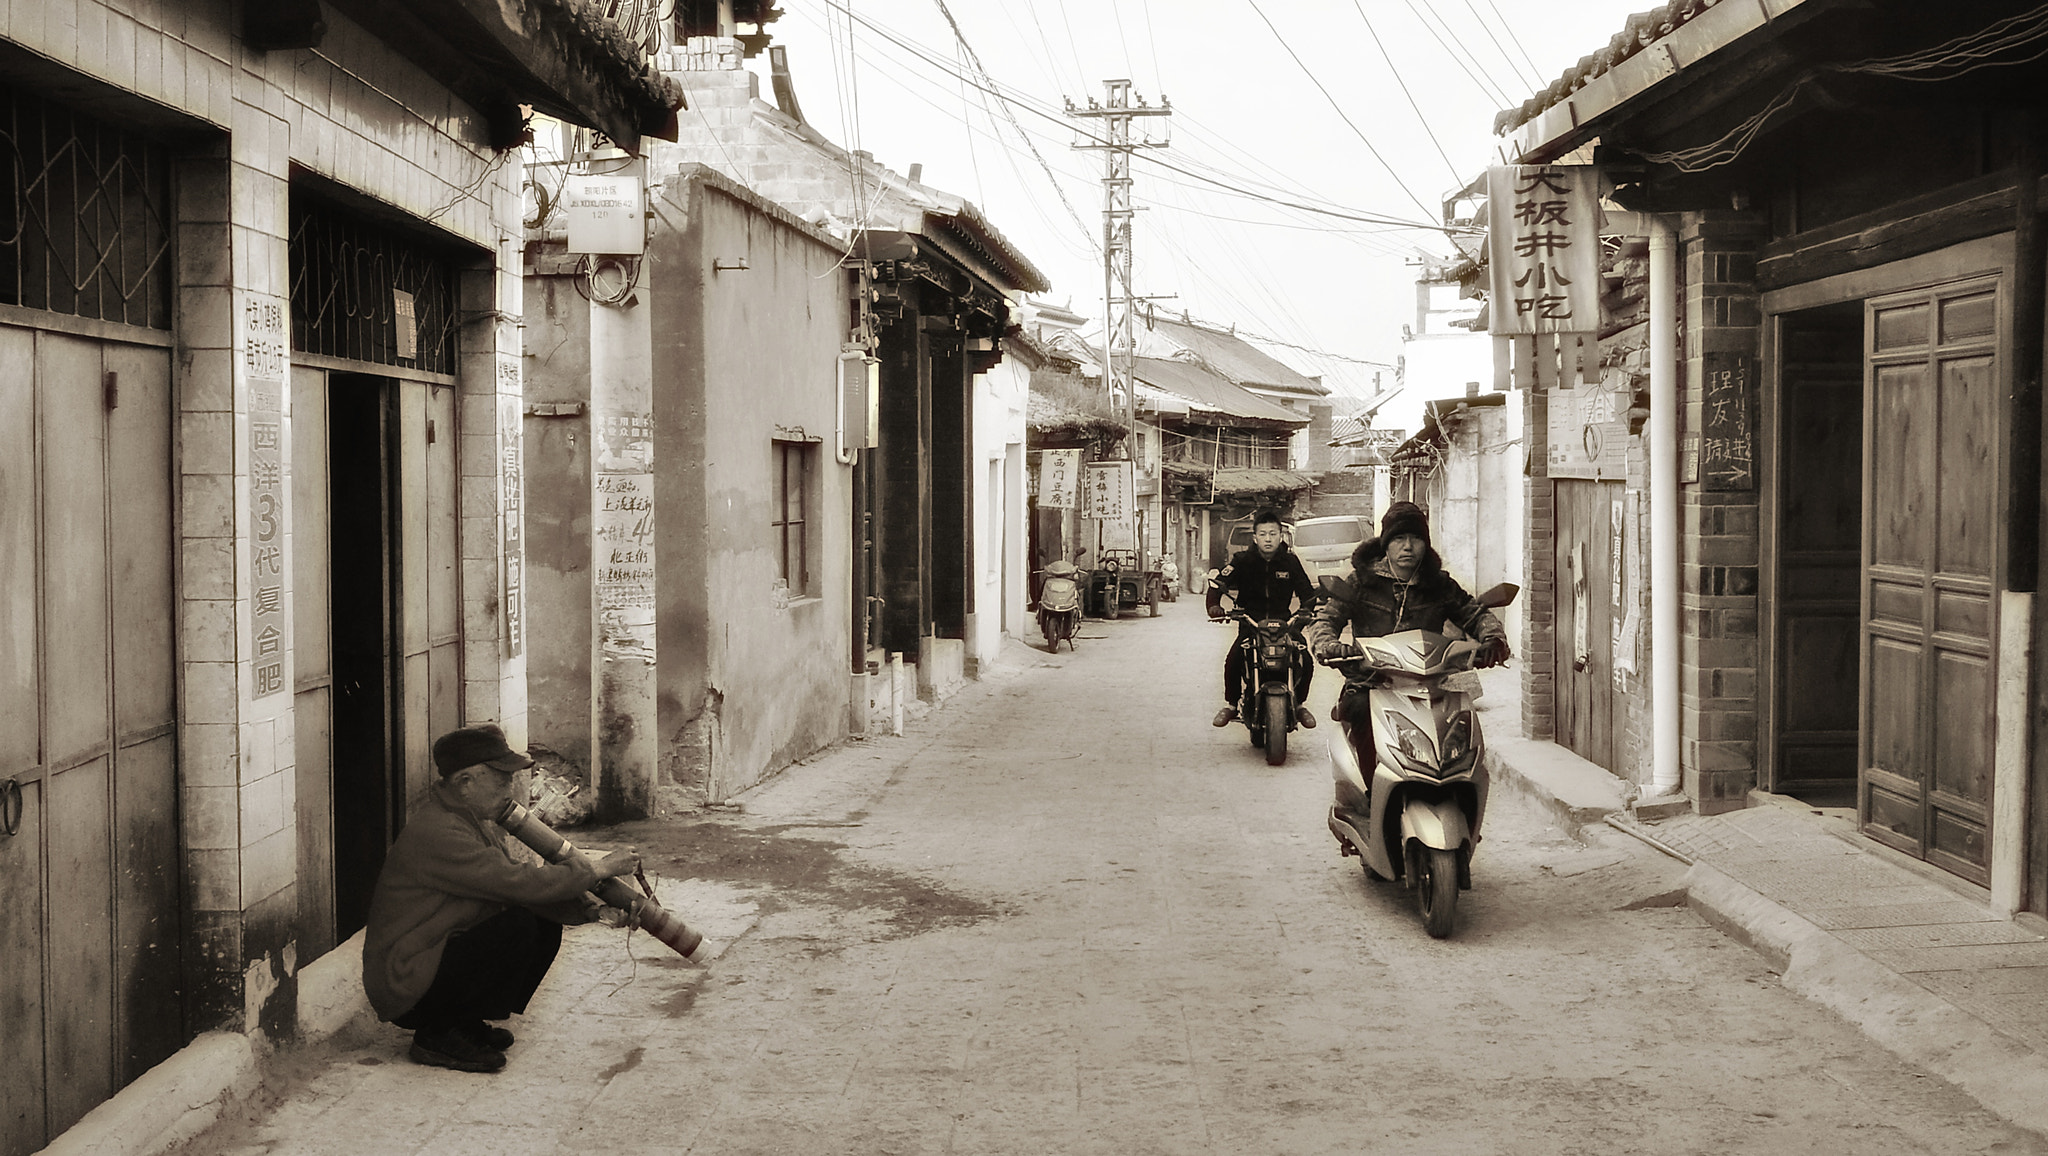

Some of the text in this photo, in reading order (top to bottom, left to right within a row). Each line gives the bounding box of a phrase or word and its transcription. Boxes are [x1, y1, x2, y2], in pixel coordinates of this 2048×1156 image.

[1514, 167, 1571, 320] 大板井小吃
[1049, 458, 1065, 505] 西门豆腐
[253, 422, 282, 695] 西洋3代复合肥
